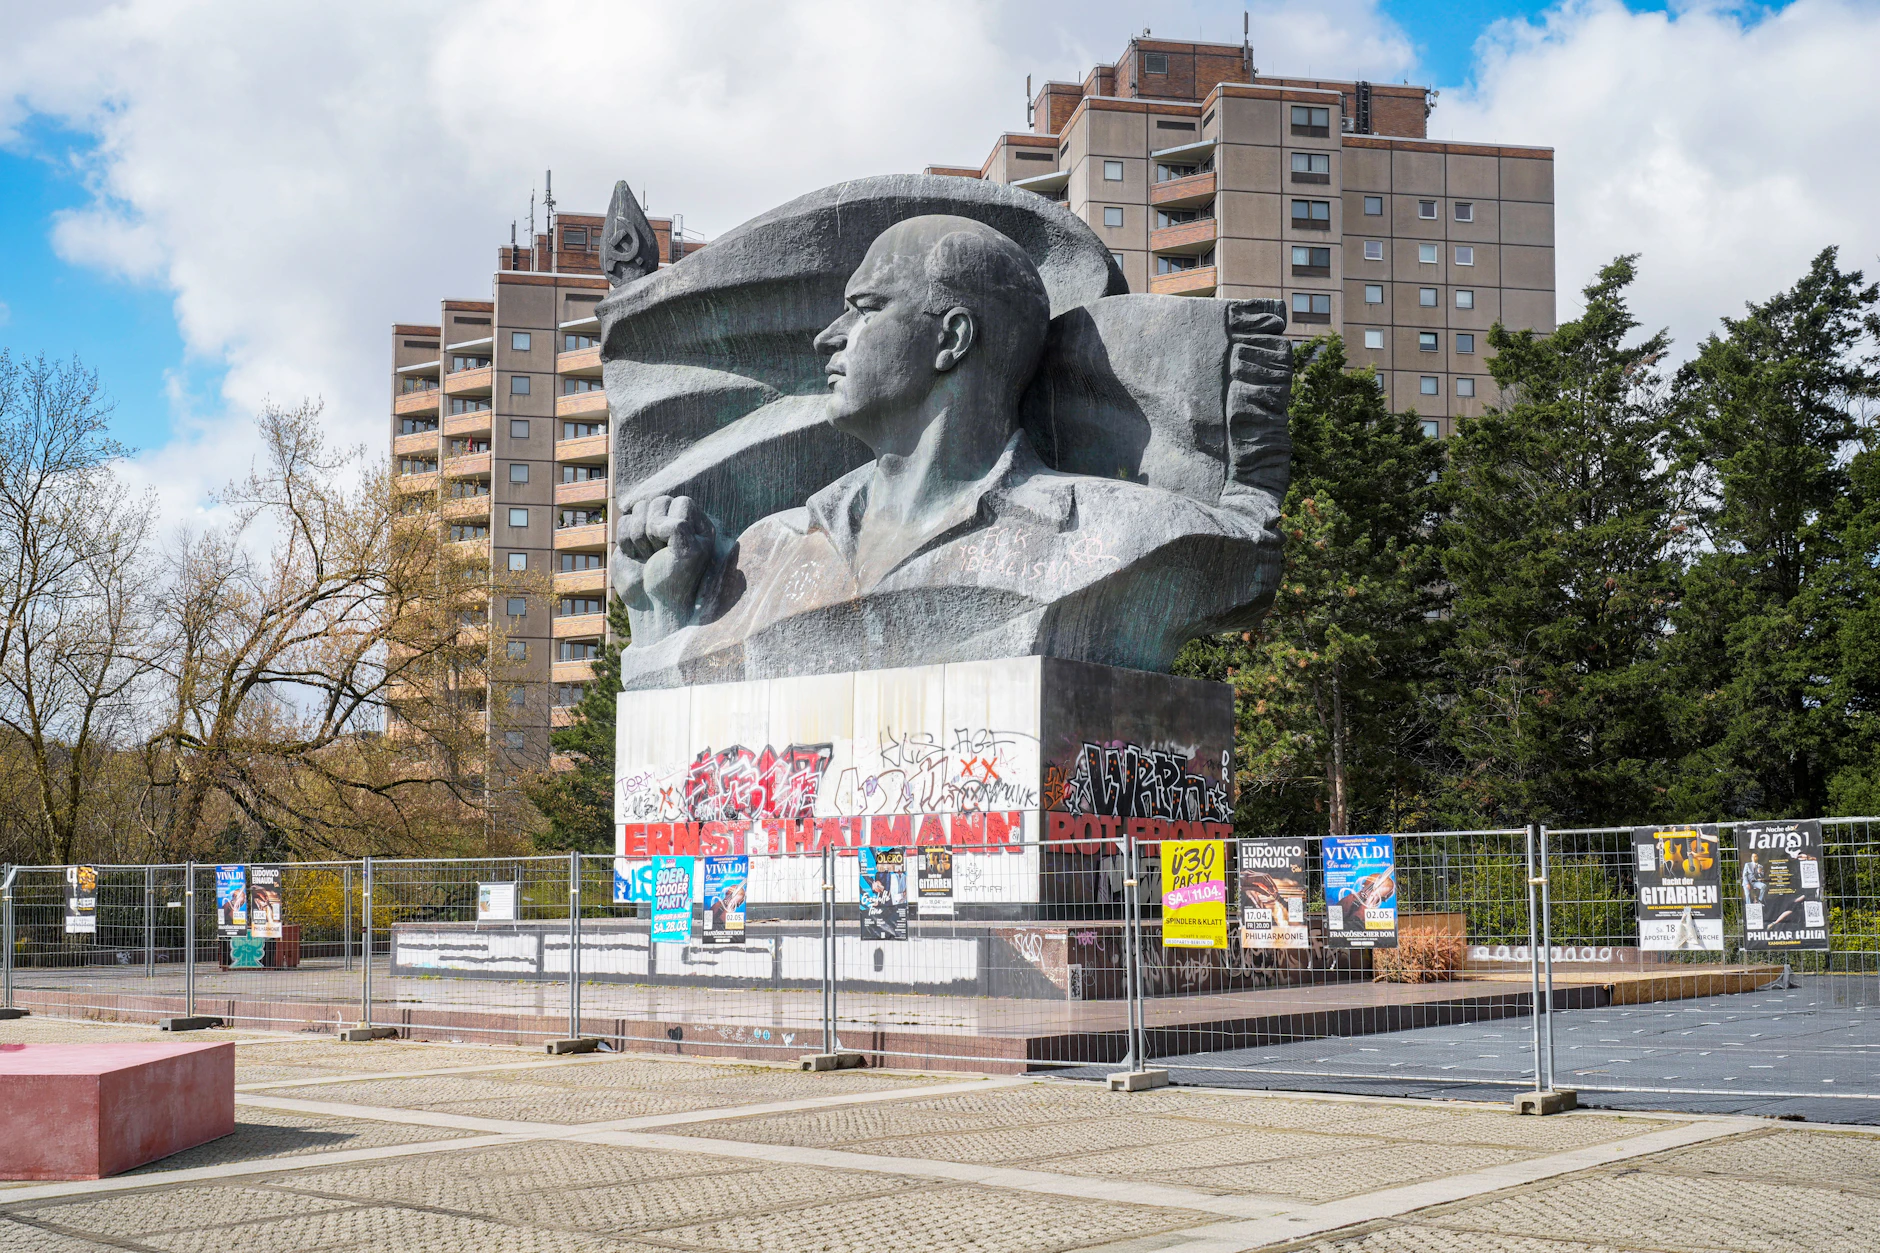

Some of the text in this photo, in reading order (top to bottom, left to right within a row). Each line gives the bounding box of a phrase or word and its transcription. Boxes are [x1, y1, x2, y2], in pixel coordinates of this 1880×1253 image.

[982, 526, 1032, 548] FCK
[960, 556, 1071, 589] IDEALISM
[1049, 811, 1122, 856] ROT
[625, 821, 751, 860] ERNST
[1242, 846, 1302, 858] LUDOVICO
[1325, 845, 1390, 859] VIVALDI
[1171, 843, 1215, 876] Ü30
[1242, 857, 1290, 869] EINAUDI
[251, 869, 279, 877] LUDOVICO
[706, 862, 747, 874] VIVALDI
[216, 871, 244, 881] VIVALDI
[251, 876, 274, 884] EINAUDI
[656, 867, 685, 885] 90ER
[1172, 870, 1212, 891] PARTY
[1662, 877, 1694, 886] Nacht der
[919, 878, 952, 889] GITARREN
[1167, 884, 1222, 906] SA. 11.04.
[1640, 885, 1718, 905] GITARREN
[656, 893, 689, 911] PARTY
[1246, 911, 1270, 920] 17.04.
[1366, 911, 1392, 919] 02.05.
[1165, 917, 1197, 925] SPINDLER
[1202, 918, 1223, 926] KLATT
[1245, 932, 1304, 940] PHILHARMONIE
[1329, 930, 1395, 938] FRANZÖSISCHER DOM
